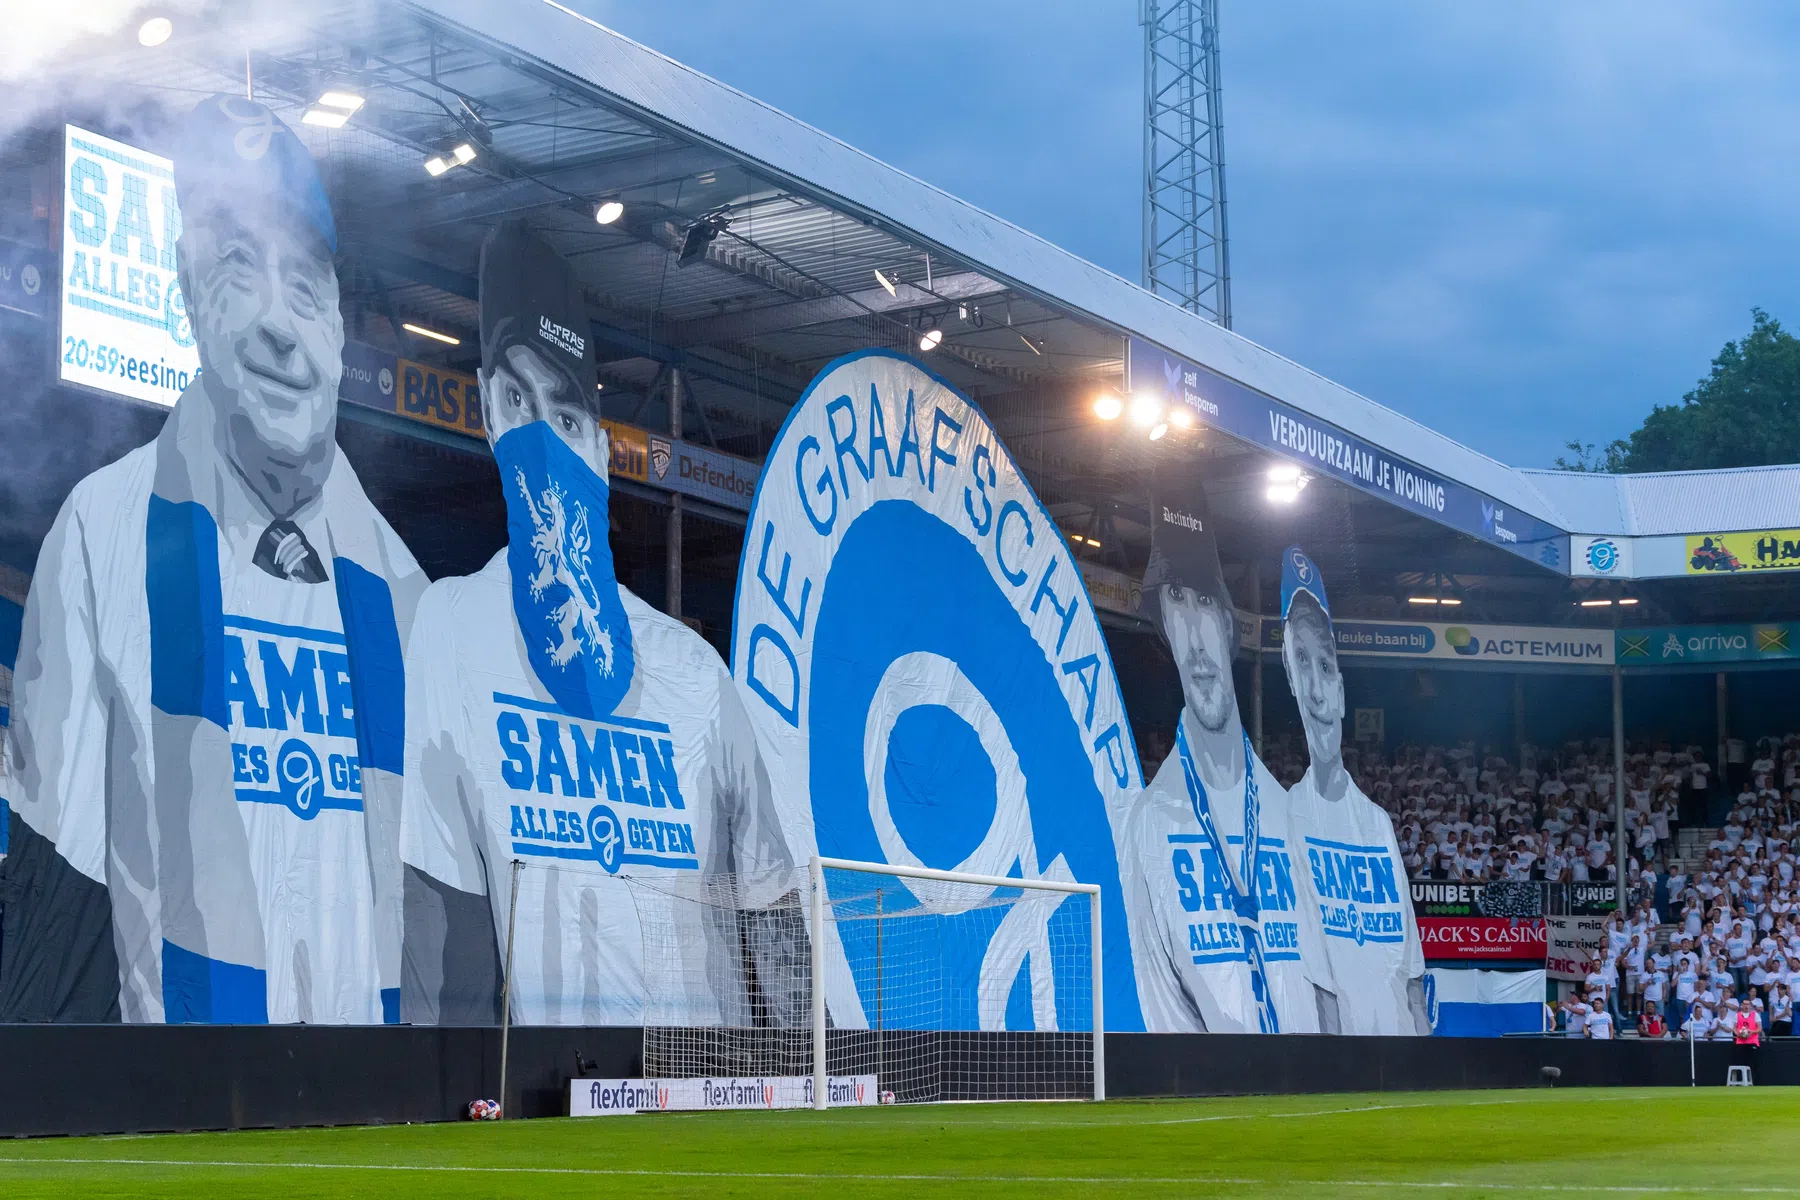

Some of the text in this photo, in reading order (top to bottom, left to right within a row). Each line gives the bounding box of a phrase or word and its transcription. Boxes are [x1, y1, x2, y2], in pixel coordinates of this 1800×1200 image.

[69, 251, 160, 311] ALLES
[539, 328, 583, 360] DOETINCHEM
[540, 315, 585, 350] ULTRAS
[63, 335, 120, 375] 20:59
[404, 365, 460, 424] BAS
[1184, 371, 1197, 388] zelf
[1184, 387, 1219, 417] besparen
[679, 455, 755, 497] Defendos
[1269, 410, 1445, 513] VERDUURZAAM JE WONING
[747, 383, 1130, 790] DE GRAAFSCHAP
[1338, 631, 1373, 646] leuke
[1374, 633, 1408, 648] baan
[1411, 634, 1427, 649] bij
[1483, 638, 1603, 659] ACTEMIUM
[1687, 633, 1747, 651] arriva
[496, 711, 687, 811] SAMEN
[510, 805, 583, 848] ALLES
[628, 821, 695, 854] GEVEN
[1171, 848, 1297, 913] SAEN
[1308, 848, 1400, 904] SAMEN
[1411, 885, 1483, 903] UNIBET
[1576, 887, 1635, 901] UNIBT
[1188, 921, 1298, 951] ALLES GEVE
[1420, 926, 1480, 943] JACK'S
[1458, 946, 1512, 955] www.jackscasino.nl
[590, 1080, 669, 1109] flexfamily
[703, 1078, 773, 1108] flexfamily
[804, 1077, 865, 1105] flfamily
